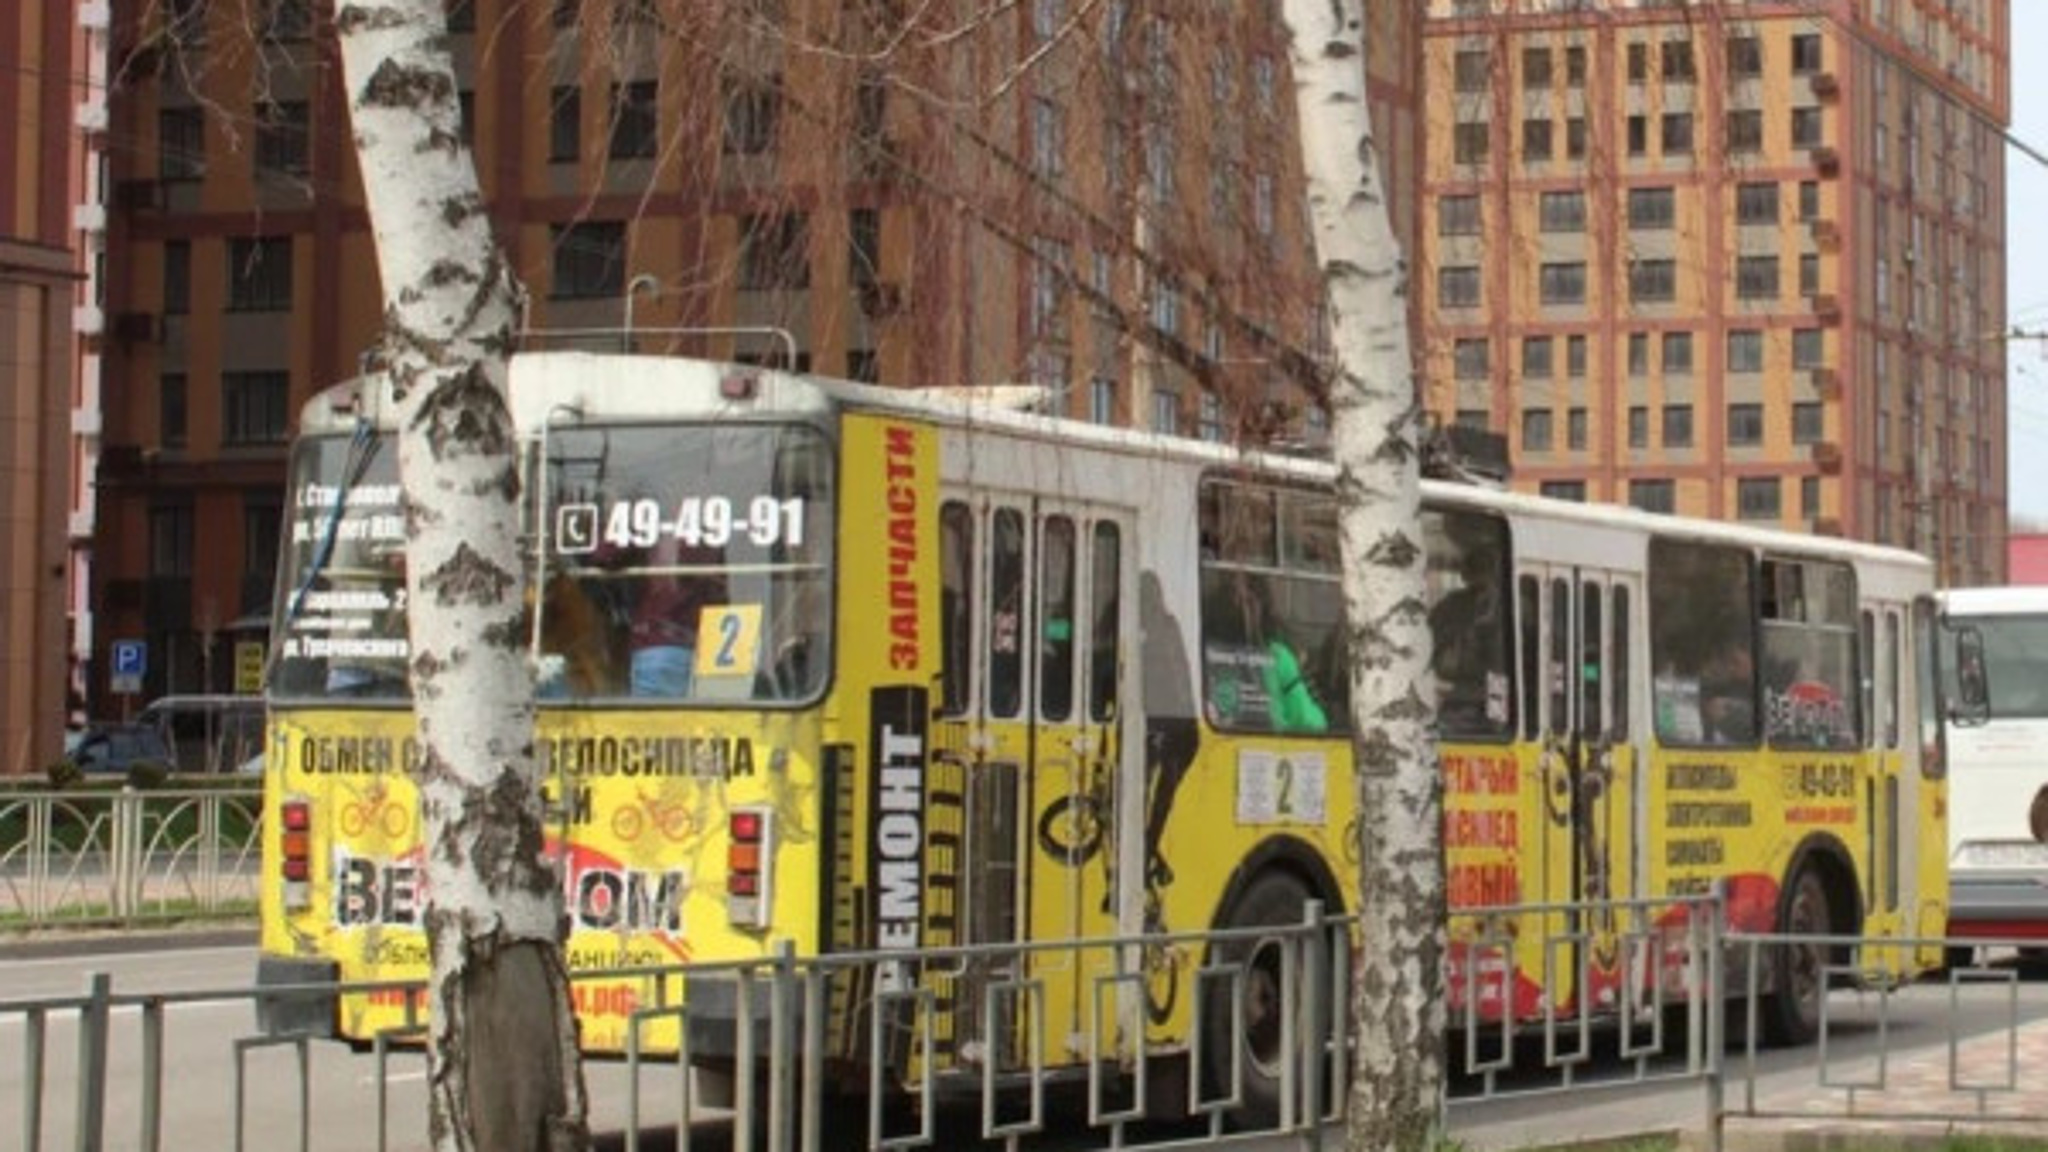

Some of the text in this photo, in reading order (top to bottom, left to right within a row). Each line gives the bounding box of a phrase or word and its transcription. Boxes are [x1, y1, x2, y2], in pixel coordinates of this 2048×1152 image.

[605, 496, 804, 547] 49-49-91
[885, 427, 918, 671] ЗАПЧАСТИ
[119, 645, 138, 671] P
[715, 613, 741, 668] 2
[300, 735, 394, 775] ОБМЕН
[1276, 757, 1295, 815] 2
